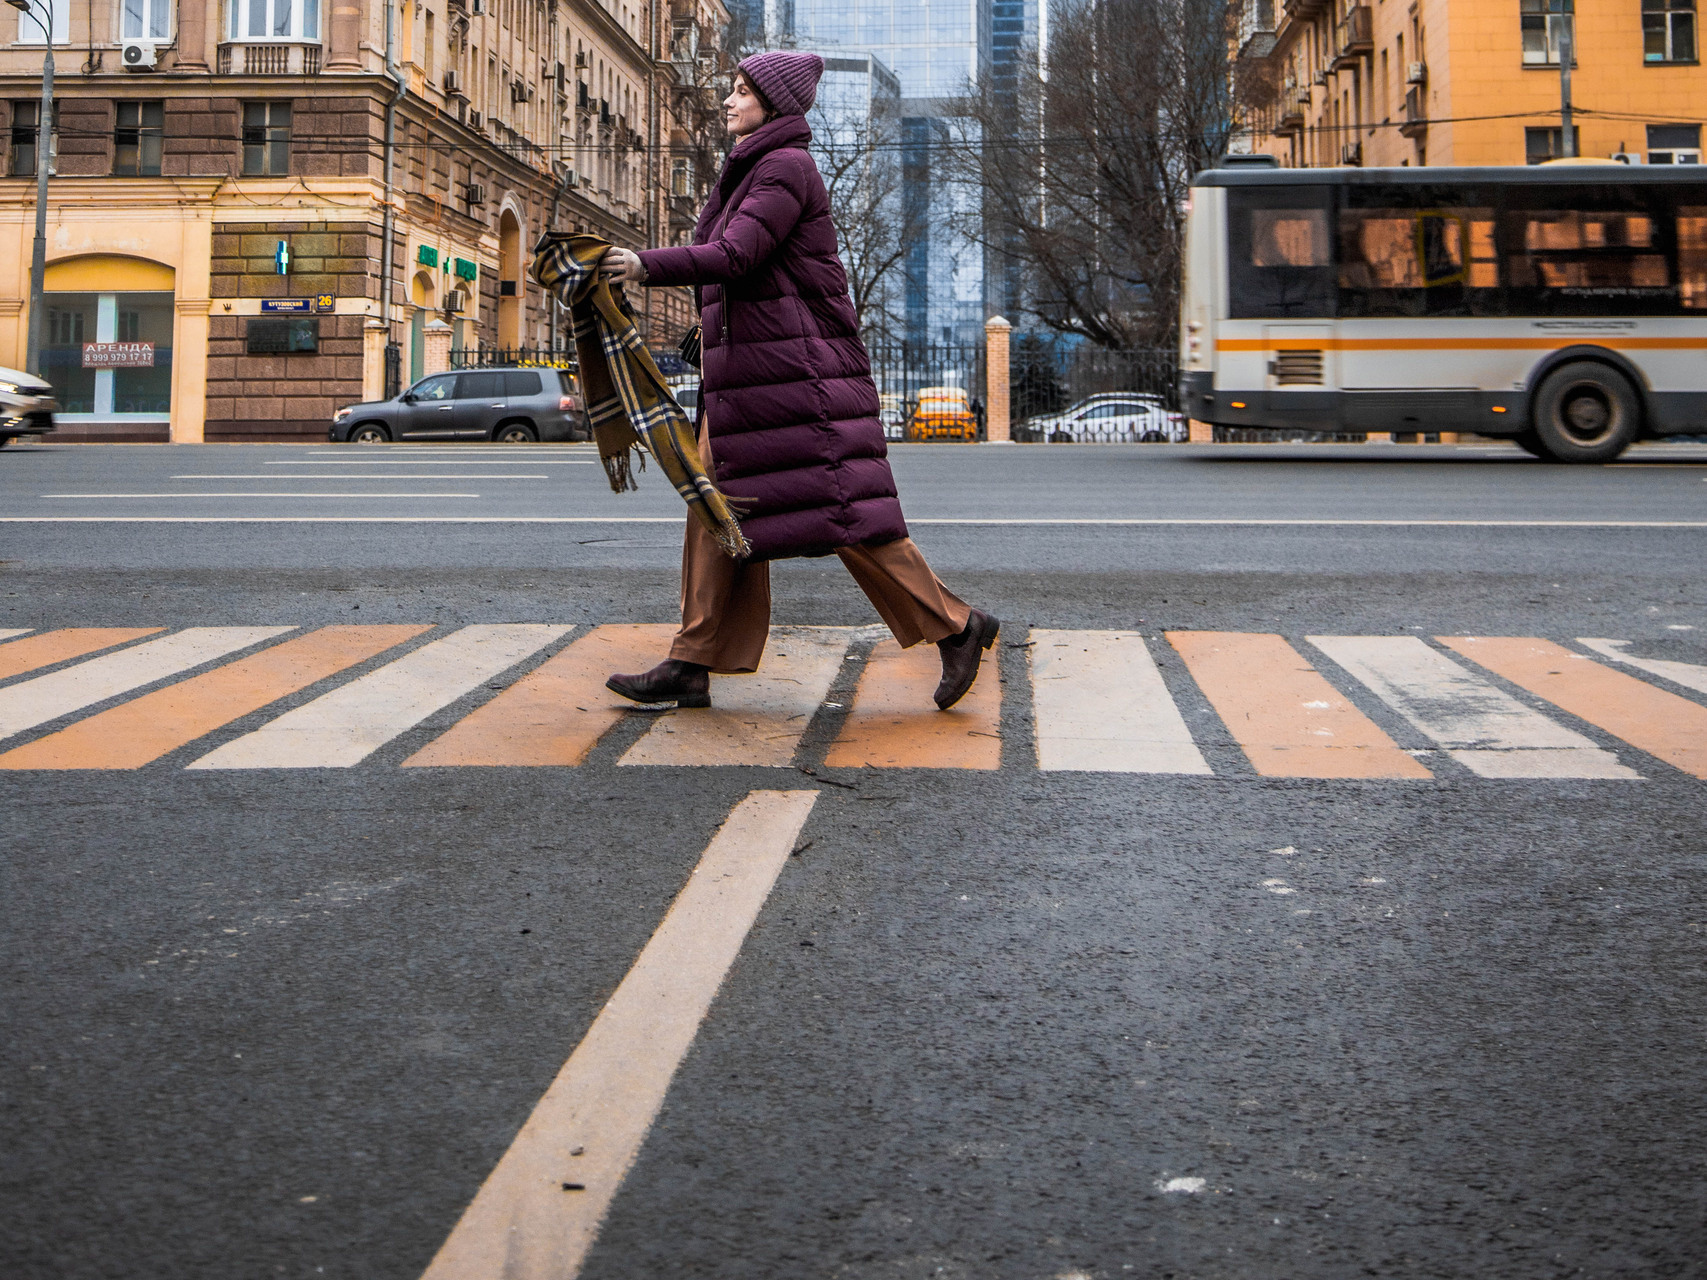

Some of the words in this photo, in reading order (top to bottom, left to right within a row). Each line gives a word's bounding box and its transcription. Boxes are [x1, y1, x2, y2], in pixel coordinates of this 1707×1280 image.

[319, 295, 332, 306] 26
[86, 343, 152, 352] АРЕНДА
[110, 353, 126, 361] 979
[130, 353, 139, 361] 17
